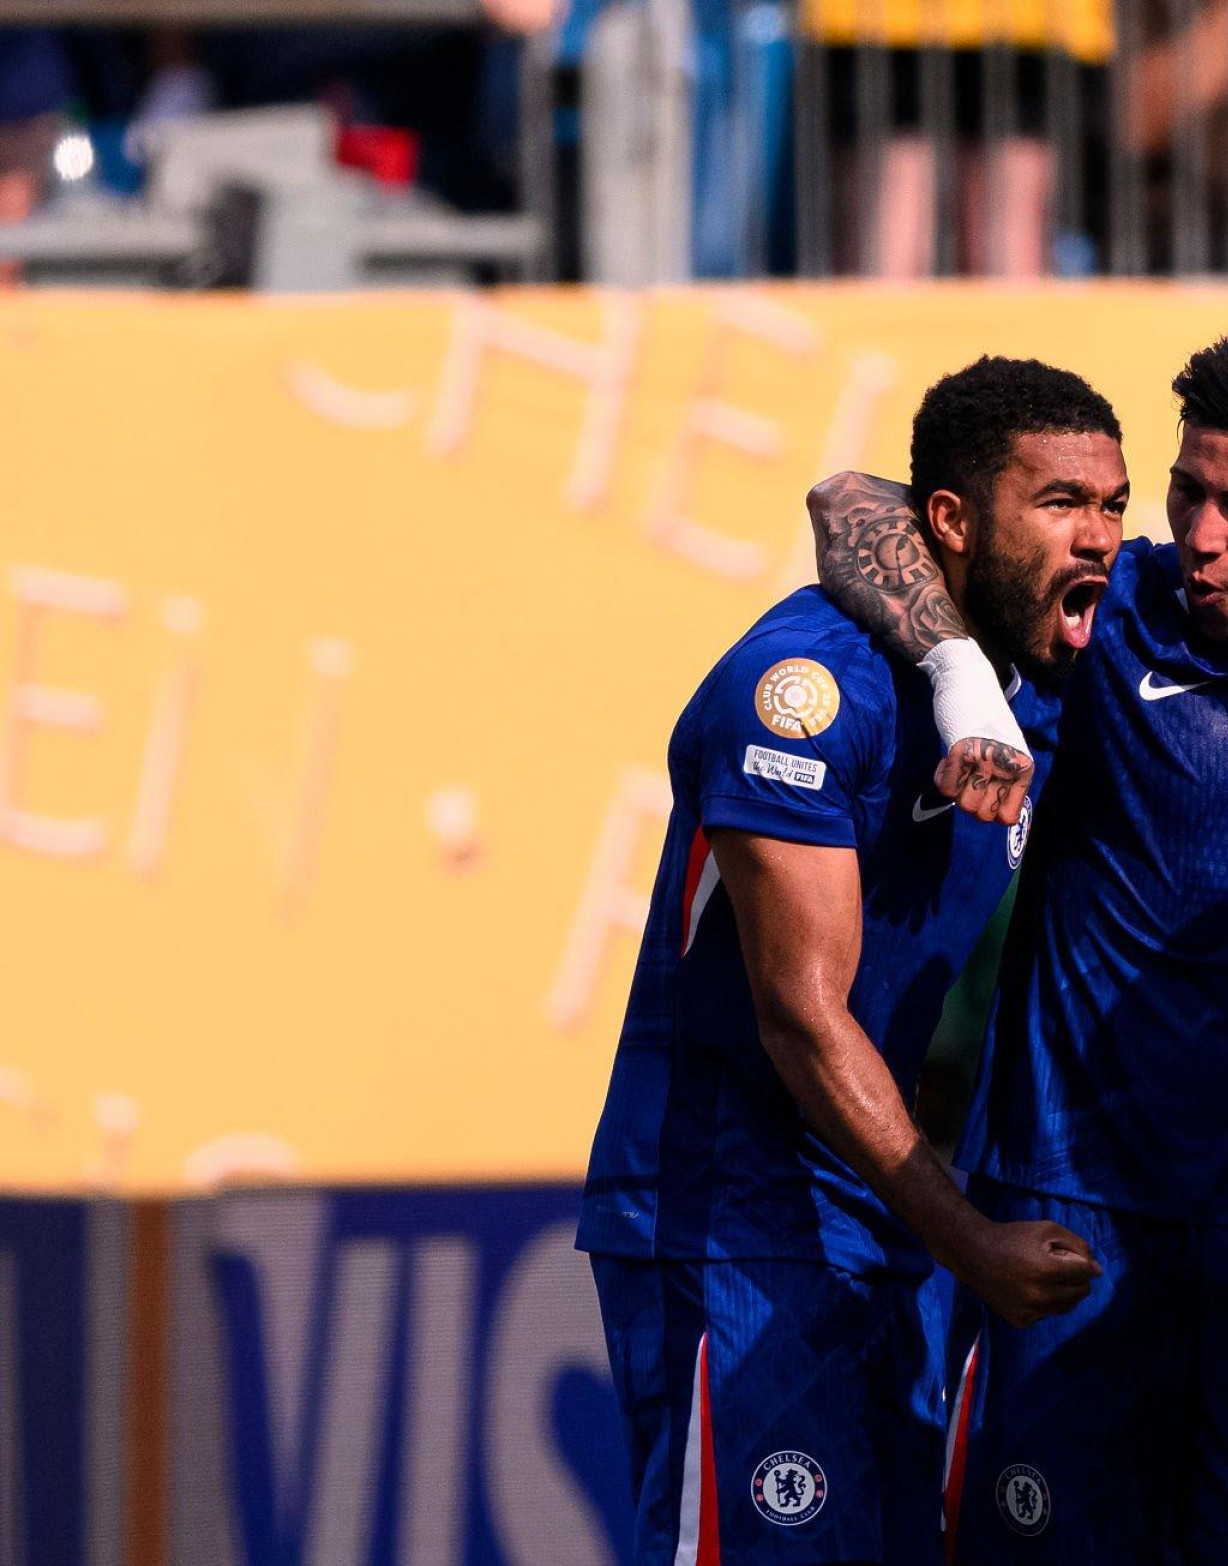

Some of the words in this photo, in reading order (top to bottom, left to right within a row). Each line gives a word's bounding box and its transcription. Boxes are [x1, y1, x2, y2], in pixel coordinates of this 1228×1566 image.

[763, 684, 773, 711] CLUB
[771, 665, 808, 682] WORLD
[770, 714, 802, 733] FIFA
[754, 749, 788, 767] FOOTBALL
[791, 757, 818, 773] UNITES
[214, 1197, 620, 1566] VIS
[763, 1453, 811, 1471] CHELSEA
